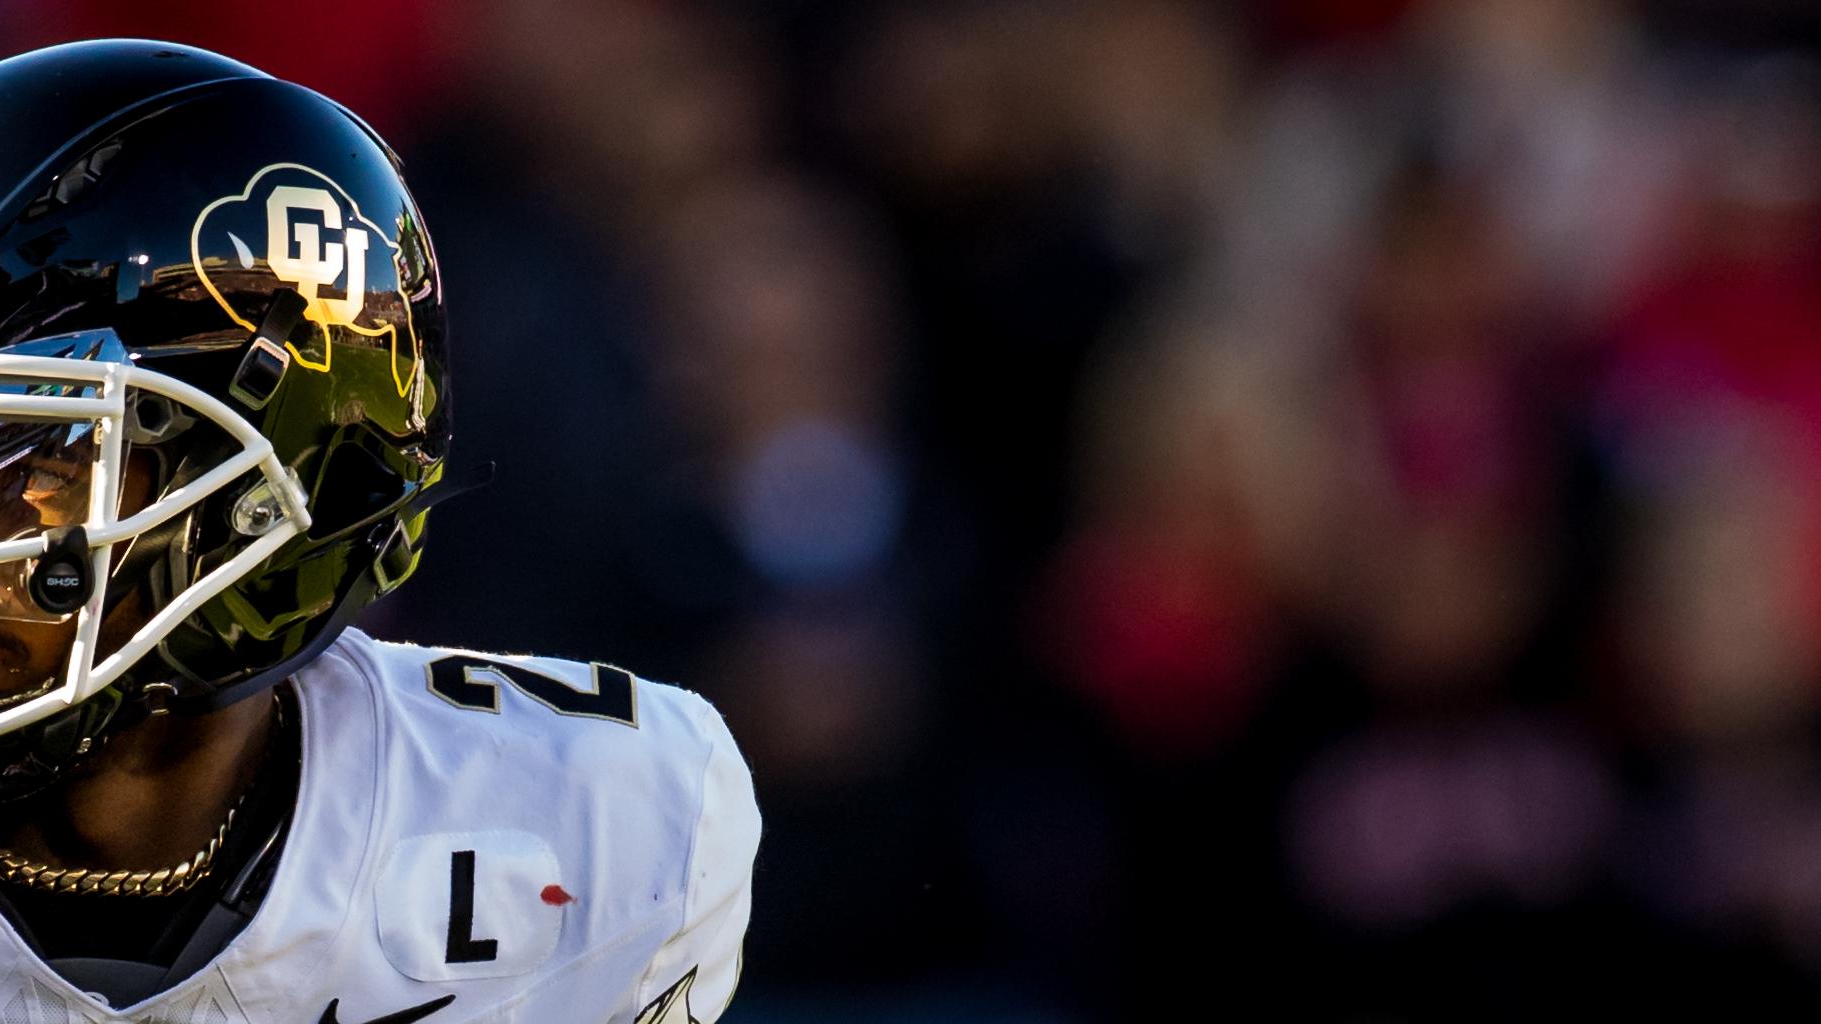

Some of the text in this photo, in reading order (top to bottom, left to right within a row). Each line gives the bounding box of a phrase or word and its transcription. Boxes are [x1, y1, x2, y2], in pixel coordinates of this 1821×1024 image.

[266, 185, 369, 325] CU
[424, 654, 639, 729] 2
[444, 850, 498, 963] L
